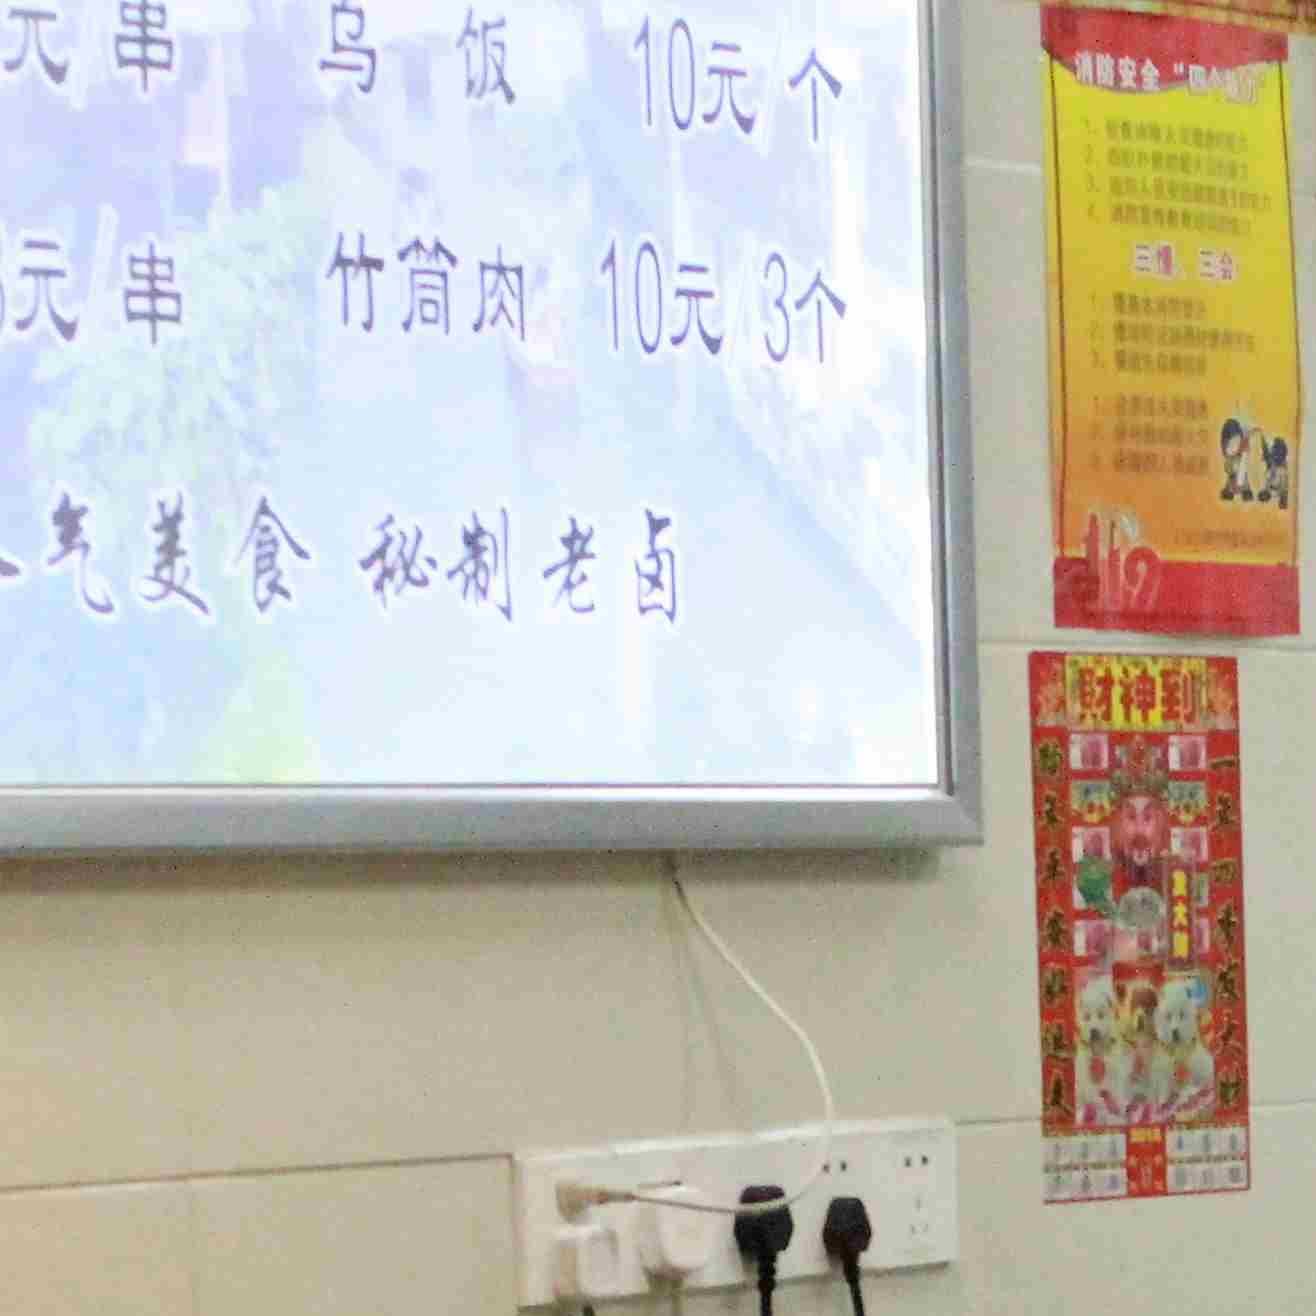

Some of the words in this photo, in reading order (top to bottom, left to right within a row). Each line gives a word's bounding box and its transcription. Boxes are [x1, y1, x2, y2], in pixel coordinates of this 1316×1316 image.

[114, 0, 174, 93] 串
[318, 0, 517, 104] 乌饭
[634, 18, 756, 136] 10元
[788, 49, 843, 142] 个
[0, 238, 78, 342] 元
[123, 241, 182, 345] 串
[325, 232, 526, 341] 竹筒肉
[601, 240, 724, 356] 10元
[763, 252, 847, 364] 3个
[0, 492, 311, 615] 气美食
[358, 506, 678, 623] 秘制老卤
